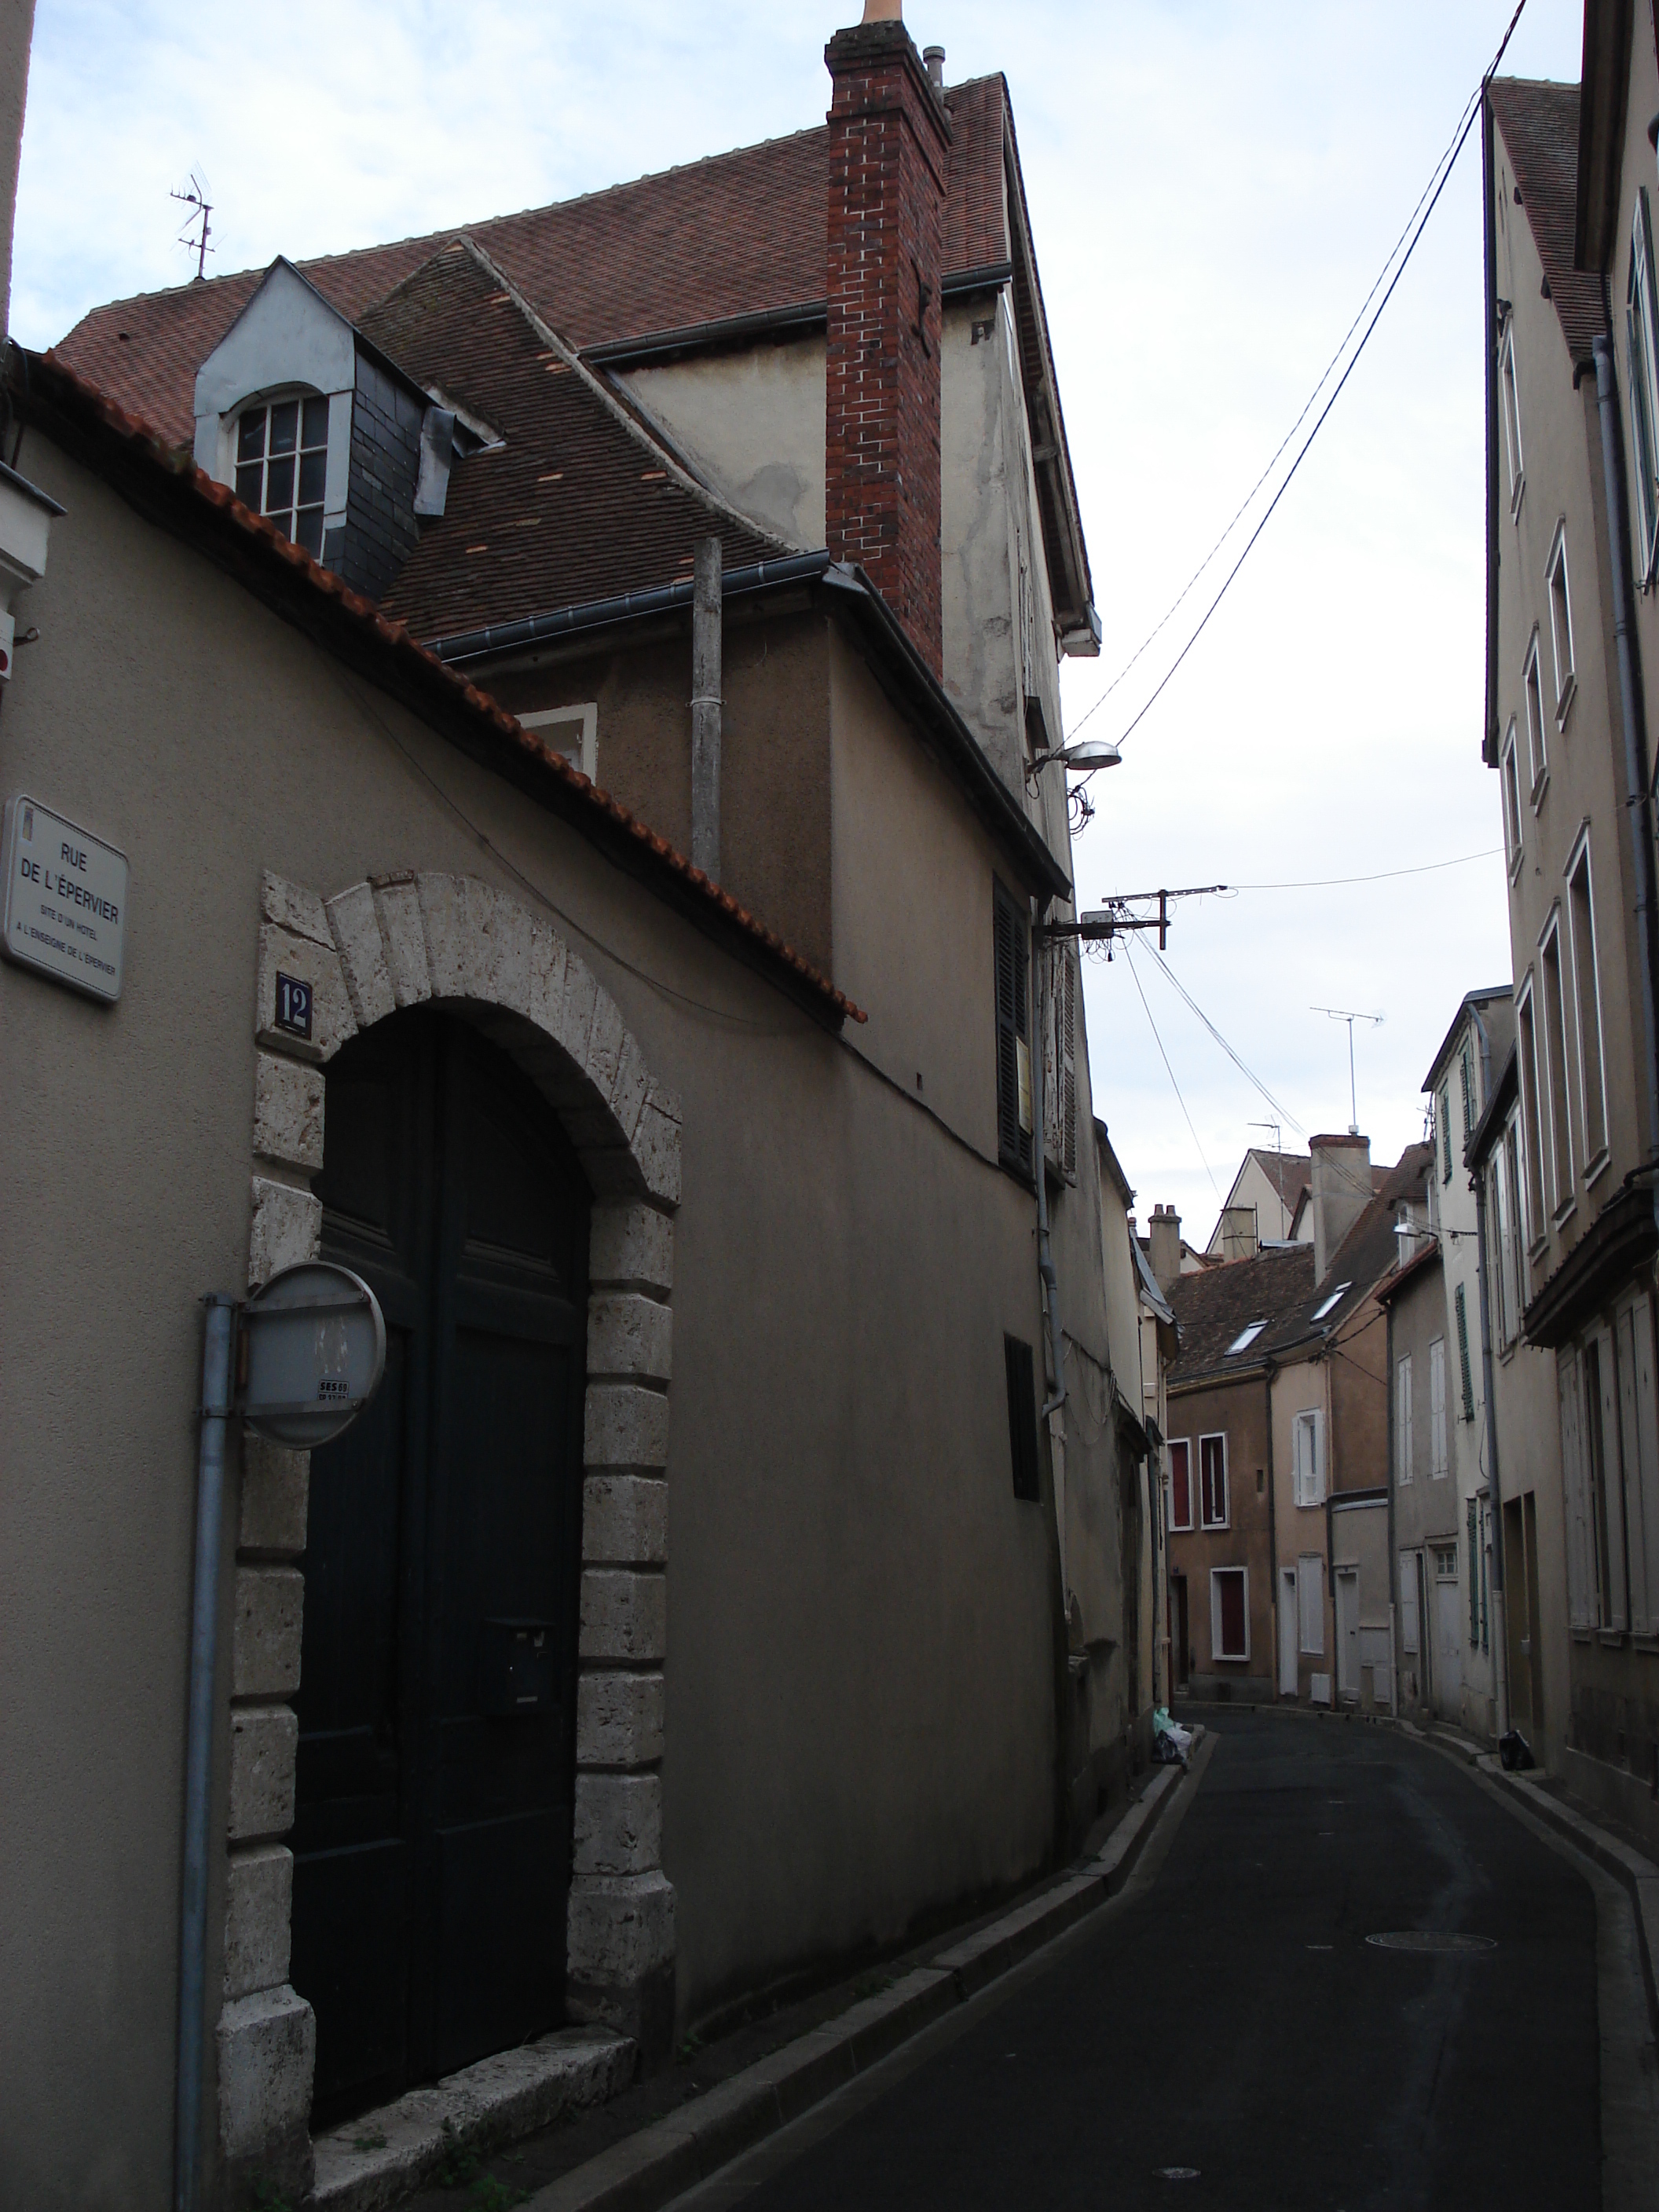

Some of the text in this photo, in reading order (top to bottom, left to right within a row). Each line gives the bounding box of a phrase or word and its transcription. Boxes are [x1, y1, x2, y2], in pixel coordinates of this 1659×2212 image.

[61, 842, 86, 872] RUE
[21, 858, 119, 925] DE L'ÉPERVIER
[41, 904, 56, 920] SITE
[24, 925, 66, 953] L'ENSEIGNE
[68, 946, 77, 958] DE
[282, 983, 307, 1028] 12
[320, 1382, 347, 1392] SES 69
